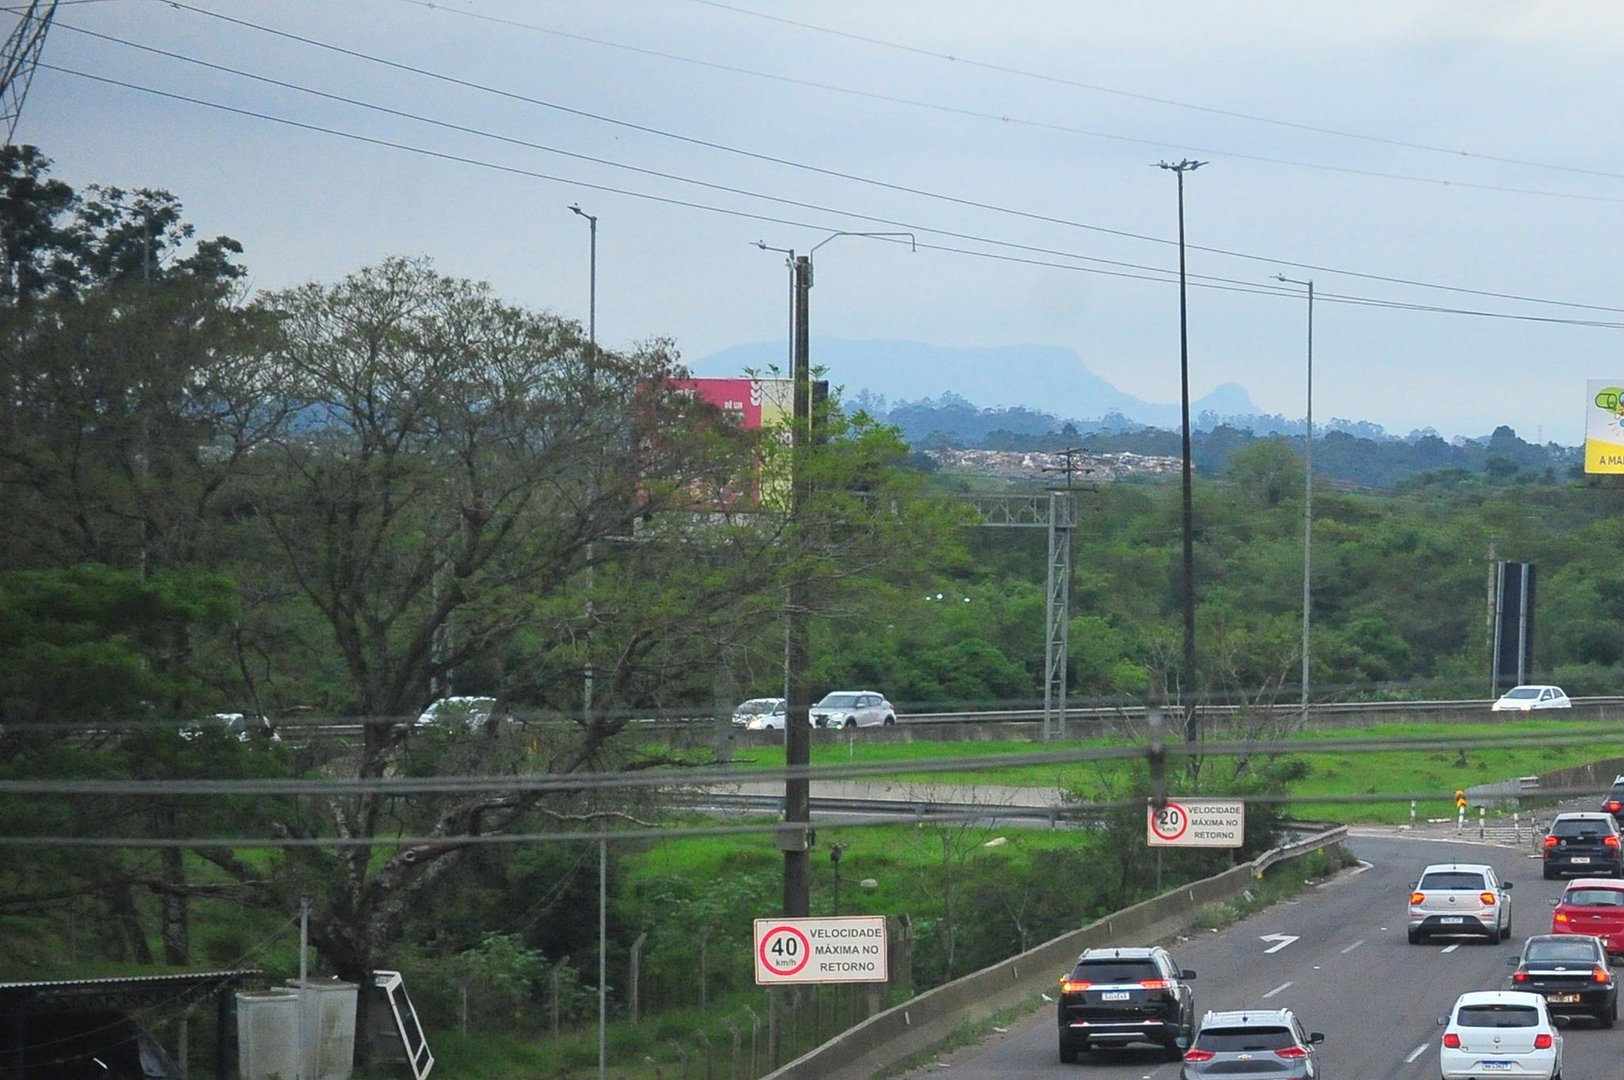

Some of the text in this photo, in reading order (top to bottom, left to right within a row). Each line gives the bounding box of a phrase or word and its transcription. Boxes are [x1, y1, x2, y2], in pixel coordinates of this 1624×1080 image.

[1599, 455, 1608, 465] A
[1159, 811, 1178, 825] 20
[1191, 818, 1224, 826] MÁXIMA
[1194, 831, 1234, 839] RETORNO
[810, 928, 882, 938] VELOCIDADE
[771, 937, 797, 956] 40
[815, 944, 879, 954] MÁXIMA NO
[820, 962, 875, 971] RETORNO
